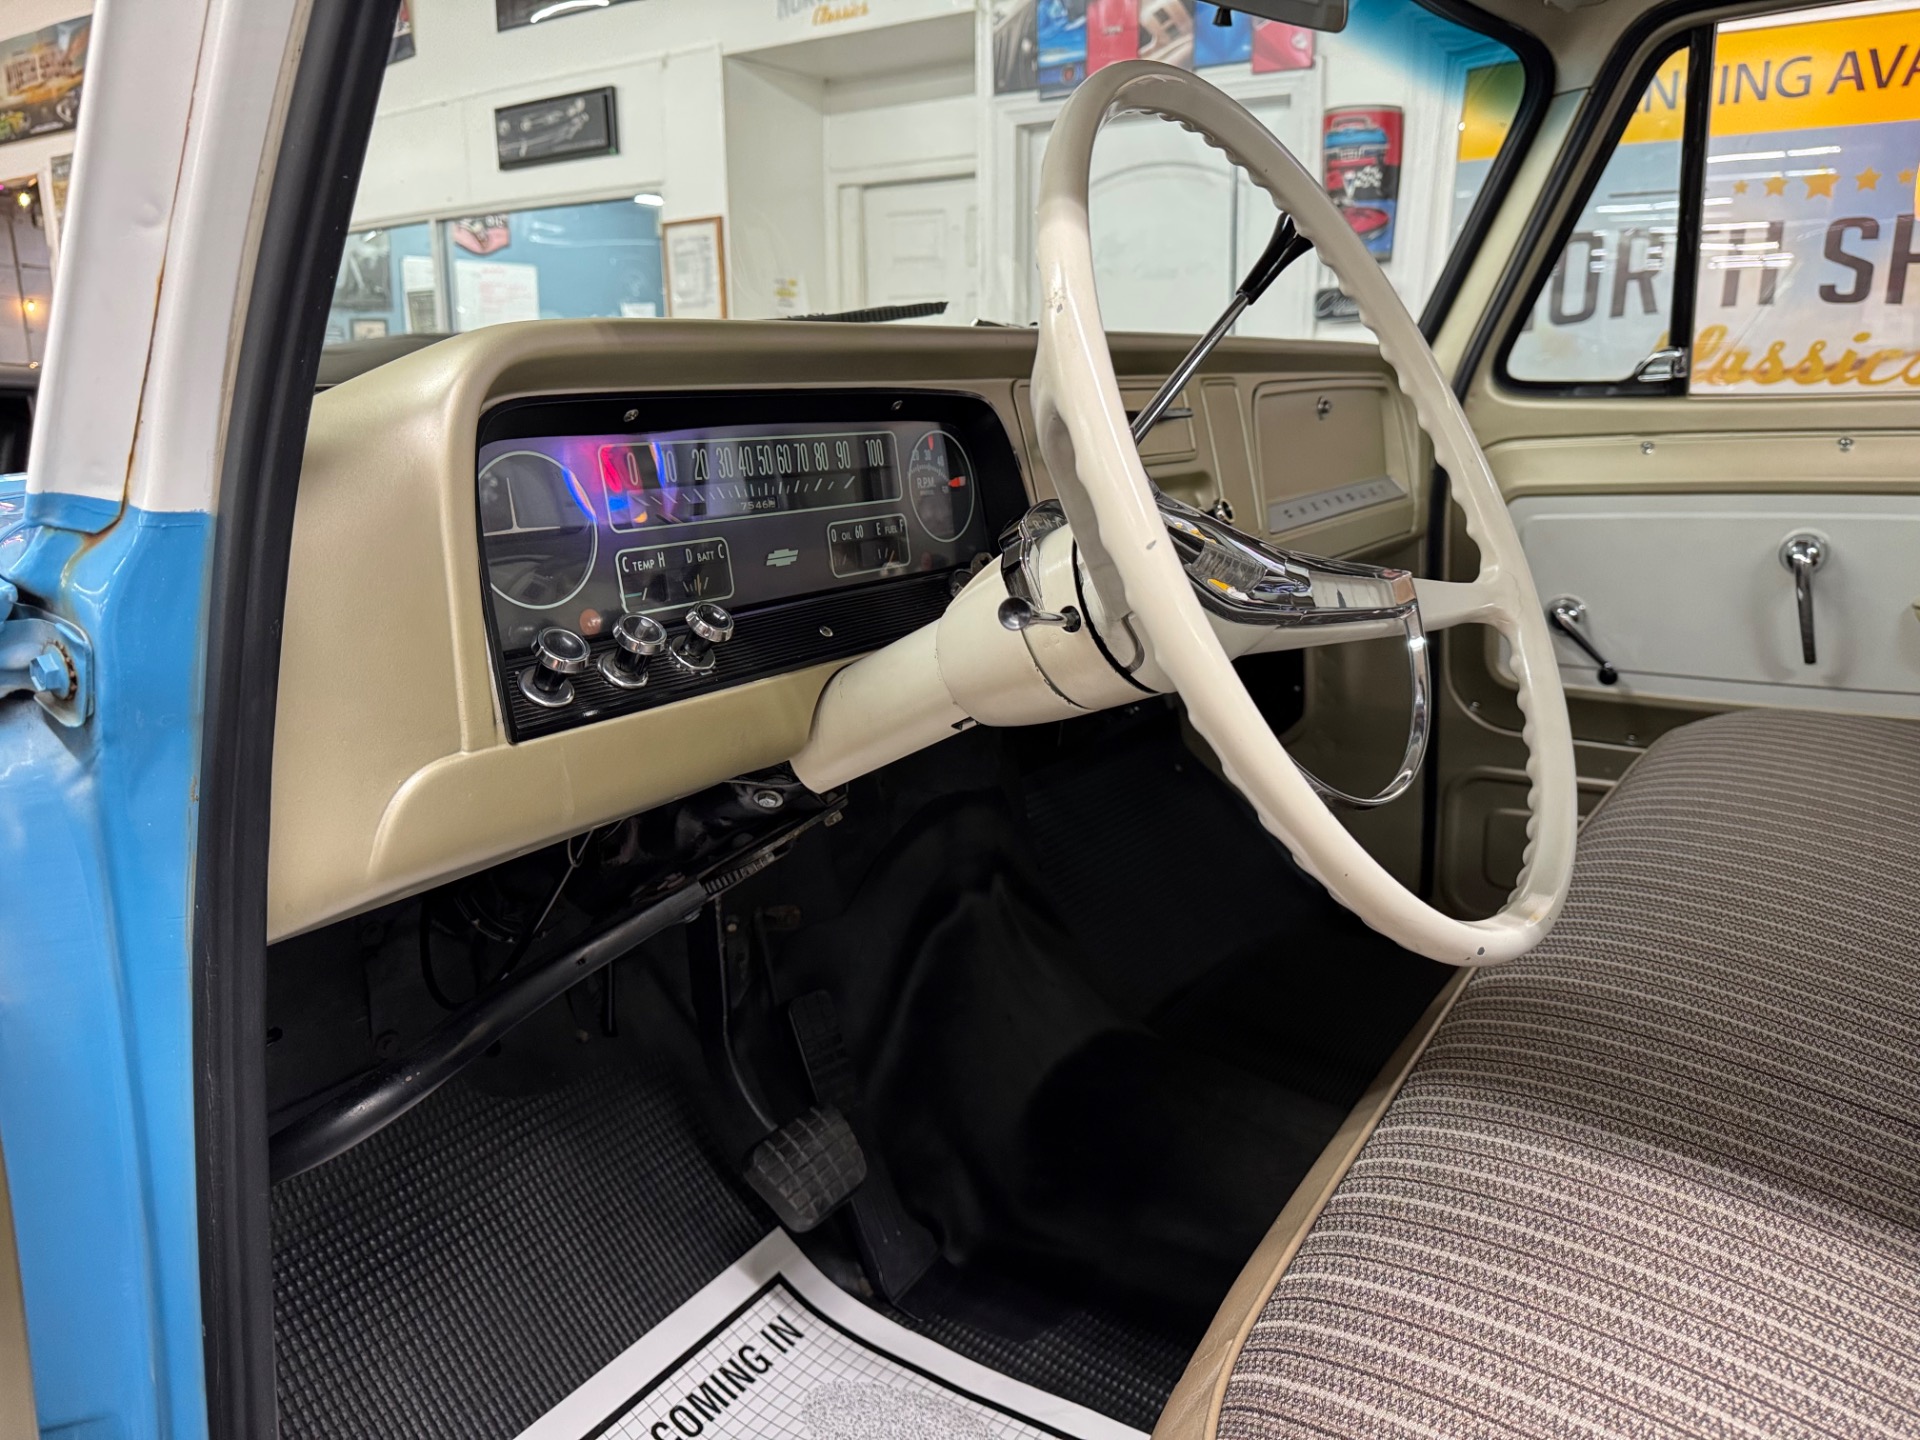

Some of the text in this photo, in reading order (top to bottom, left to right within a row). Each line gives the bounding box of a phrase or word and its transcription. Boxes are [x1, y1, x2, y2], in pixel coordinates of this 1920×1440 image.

[627, 452, 639, 486] 0
[691, 448, 710, 481] 20
[715, 447, 734, 478] 30
[738, 446, 754, 477] 40
[756, 445, 774, 476] 50
[775, 444, 792, 474] 60
[793, 443, 809, 473] 70
[813, 442, 829, 471] 80
[835, 440, 851, 470] 90
[865, 439, 884, 467] 100
[854, 524, 865, 539] 60
[884, 525, 898, 535] FUEL
[622, 543, 725, 573] C TEMP H D BATT C
[759, 1314, 805, 1354] IN
